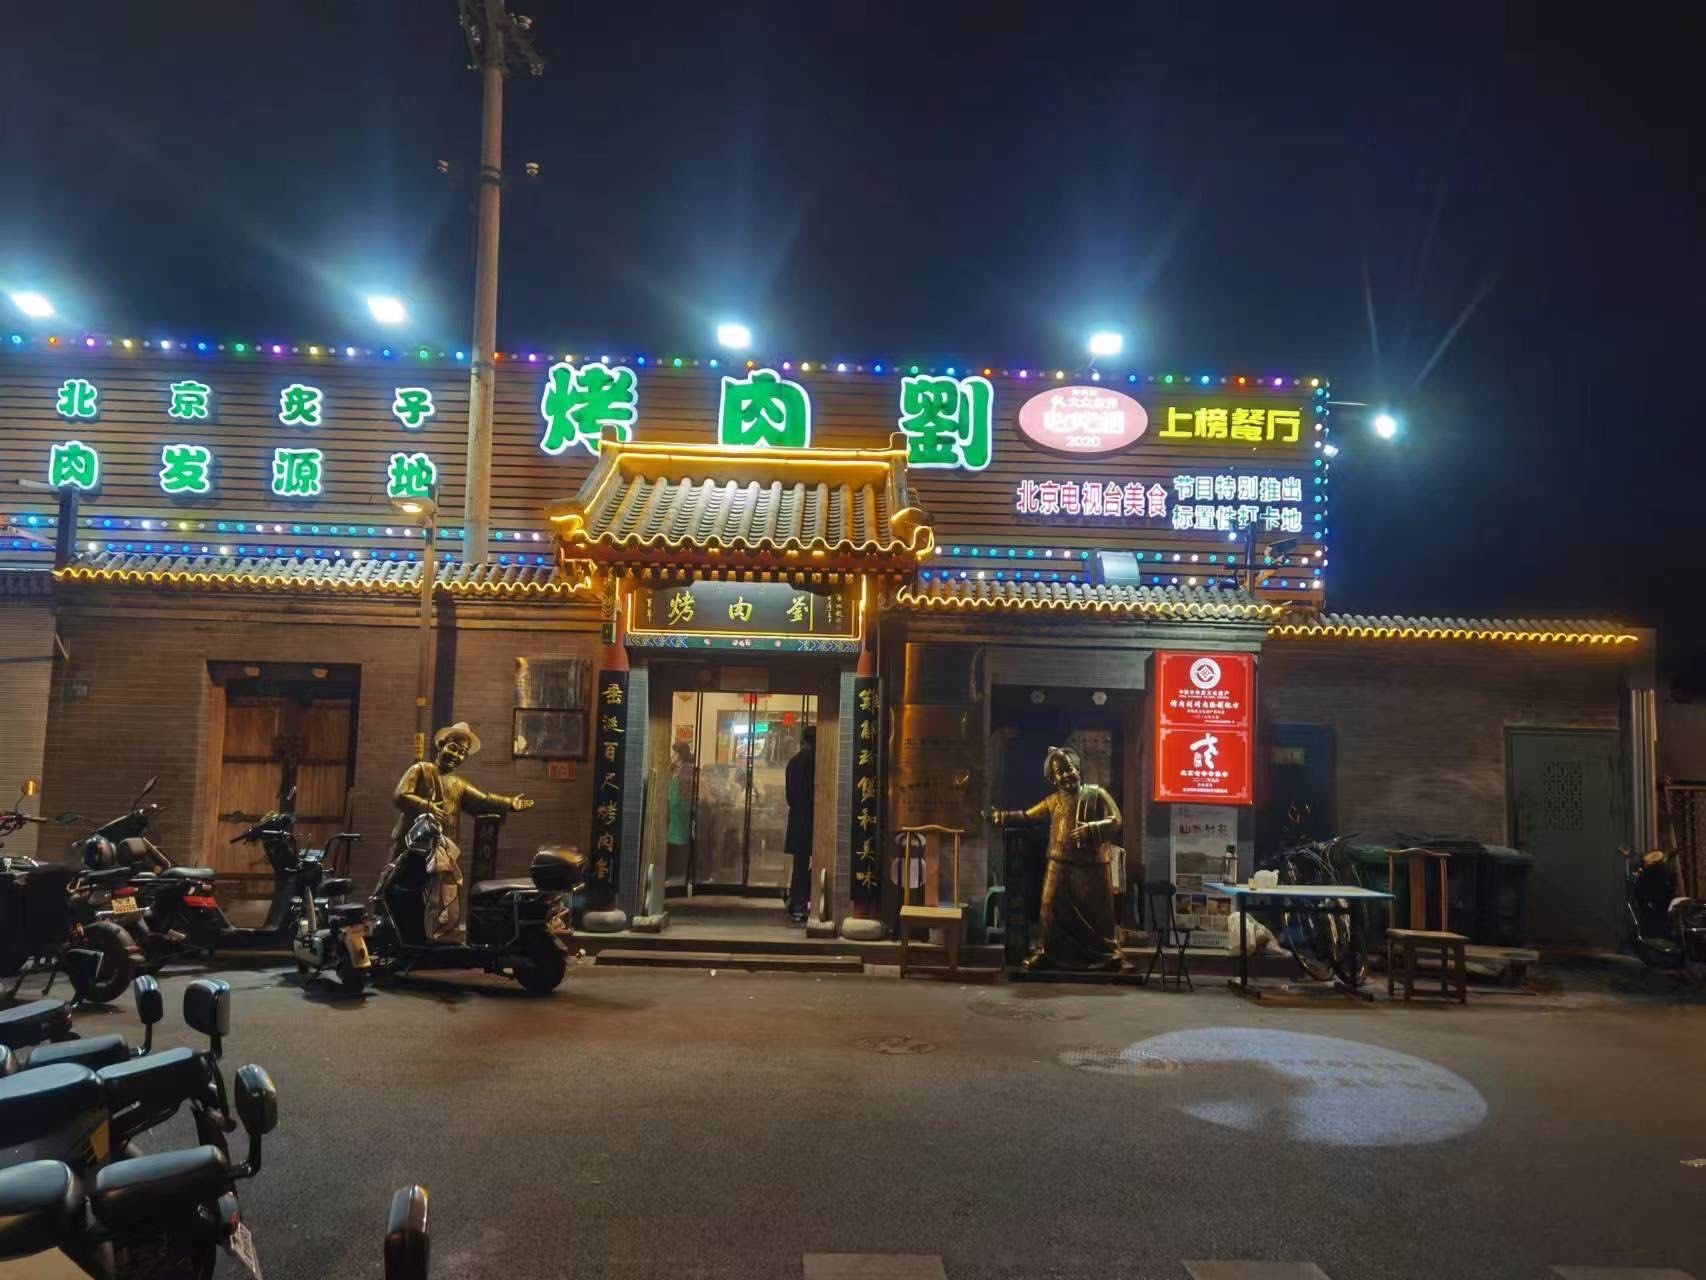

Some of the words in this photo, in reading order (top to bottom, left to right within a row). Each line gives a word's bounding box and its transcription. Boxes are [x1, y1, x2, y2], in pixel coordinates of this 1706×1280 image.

[56, 378, 436, 429] 北京炙子
[541, 362, 994, 471] 烤肉劉
[1065, 436, 1101, 448] 2020
[1159, 406, 1301, 443] 上榜餐厅
[49, 440, 436, 498] 肉发源地
[1172, 475, 1302, 502] 节目特别推出
[1016, 479, 1168, 518] 北京电视台美食
